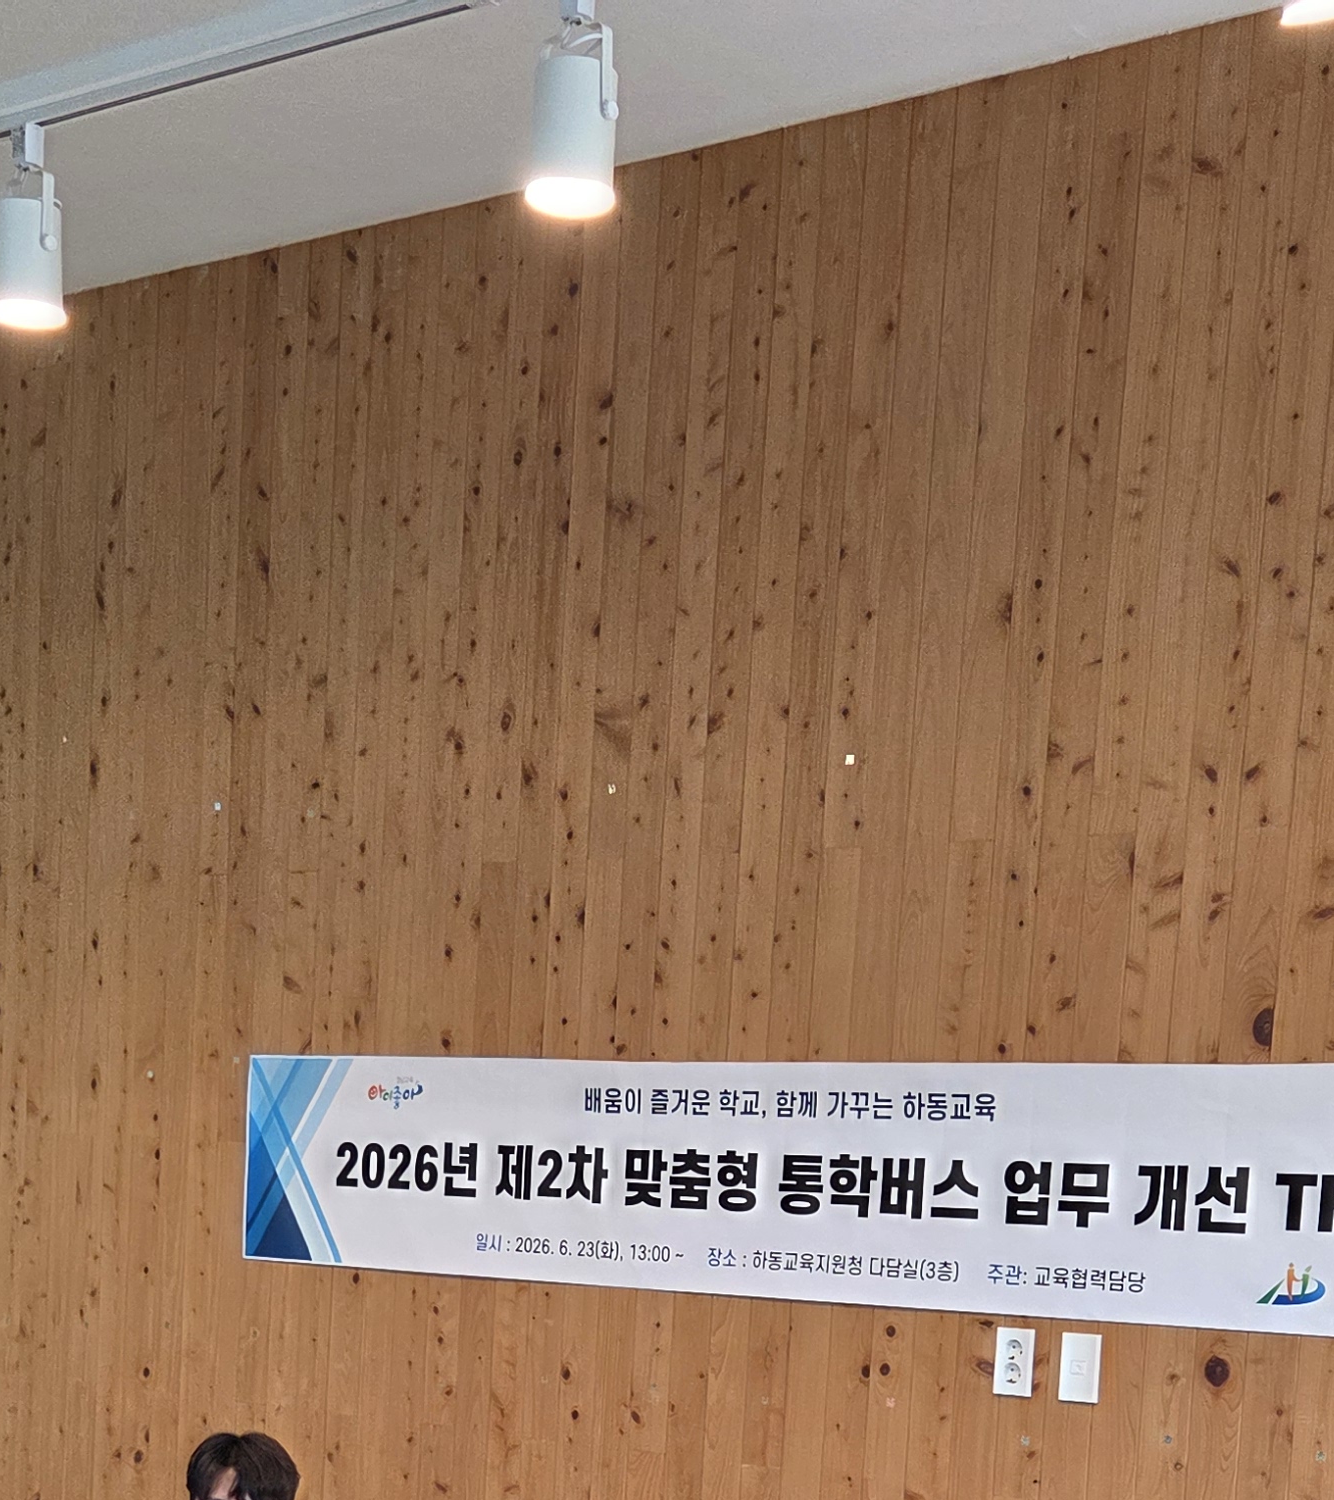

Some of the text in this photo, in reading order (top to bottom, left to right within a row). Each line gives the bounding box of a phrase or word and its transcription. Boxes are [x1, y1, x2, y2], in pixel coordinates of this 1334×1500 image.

[584, 1087, 997, 1122] 배움이 즐거운 학교, 함께 가꾸는 하동교육
[336, 1141, 478, 1198] 2026년
[495, 1144, 608, 1204] 제2차
[624, 1148, 759, 1212] 맞춤형
[778, 1153, 979, 1220] 통학버스
[1004, 1160, 1111, 1228] 업무
[1134, 1164, 1250, 1234] 개선
[476, 1233, 502, 1252] 일시
[515, 1237, 554, 1256] 2026.
[559, 1239, 572, 1256] 6.
[577, 1240, 624, 1262] 23(화),
[630, 1244, 671, 1263] 13:00
[707, 1247, 737, 1268] 장소
[753, 1249, 863, 1276] 하동교육지원청
[869, 1256, 960, 1283] 다담실(3층)
[1034, 1266, 1147, 1294] 교육협력담당
